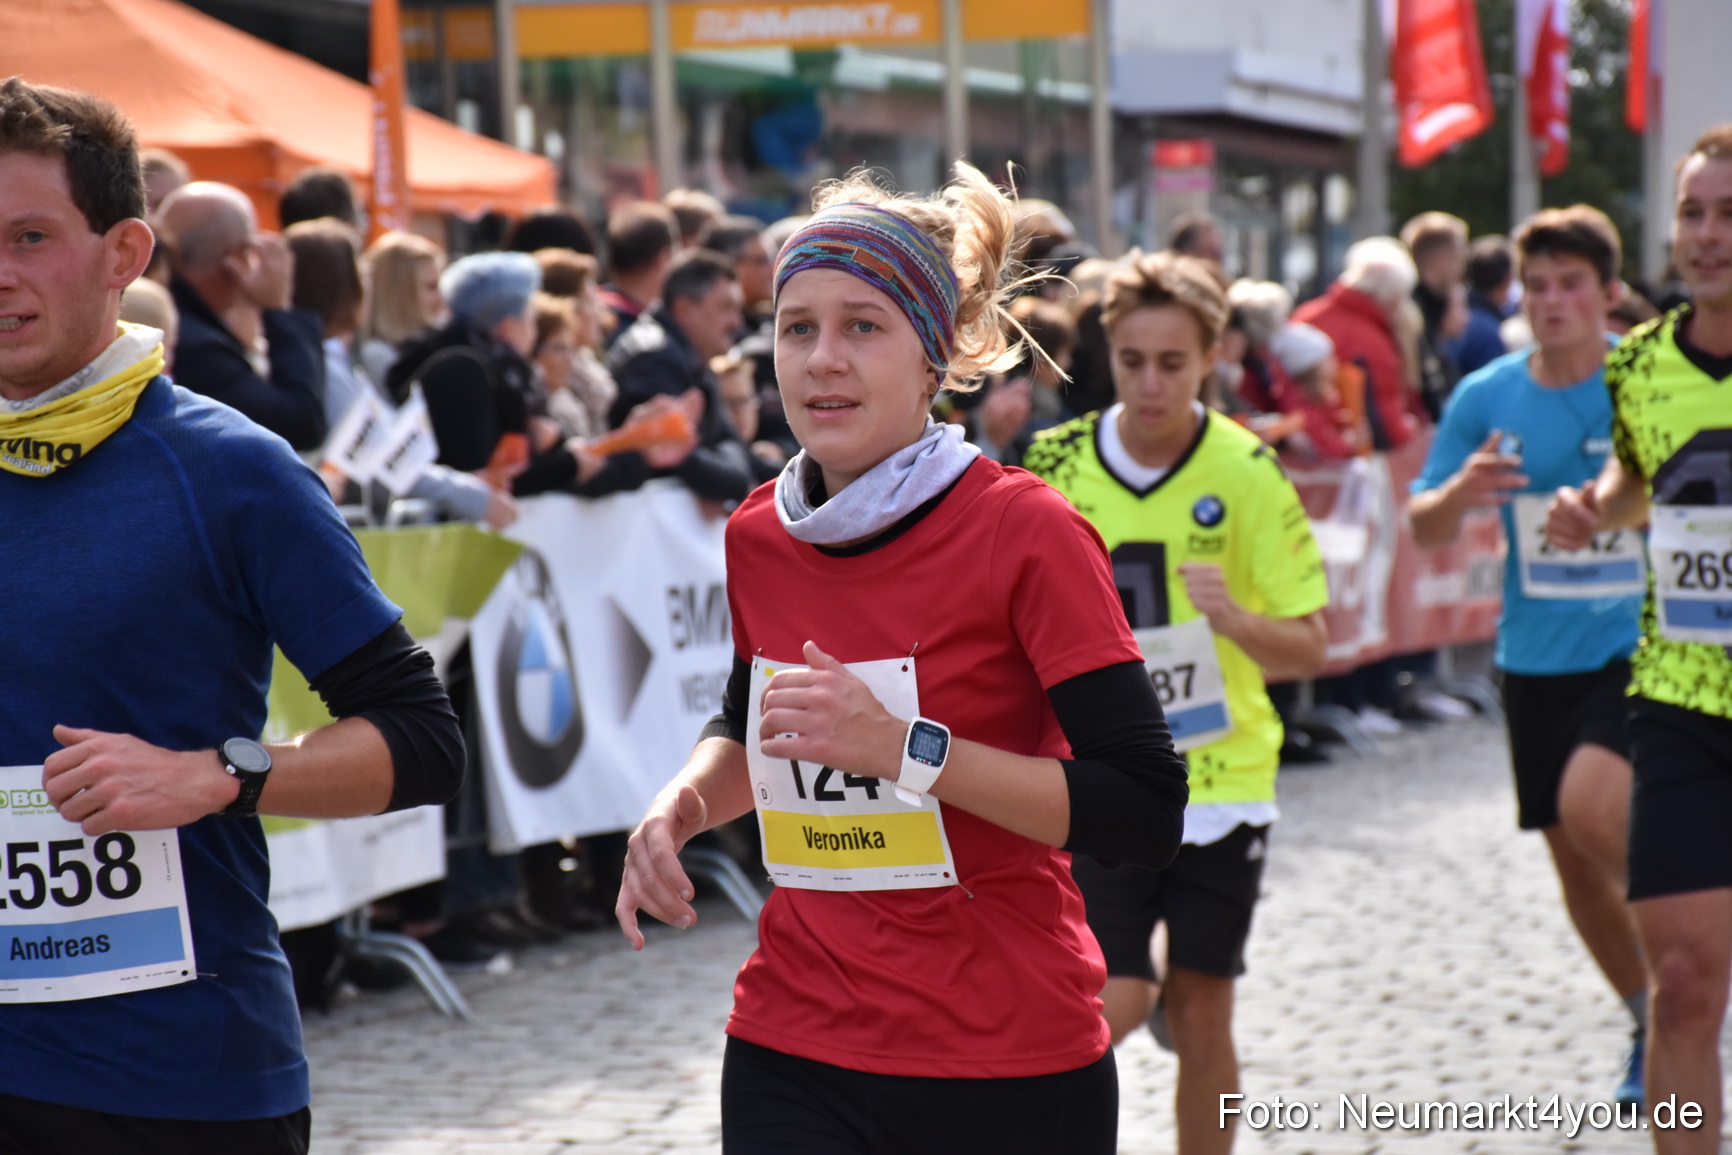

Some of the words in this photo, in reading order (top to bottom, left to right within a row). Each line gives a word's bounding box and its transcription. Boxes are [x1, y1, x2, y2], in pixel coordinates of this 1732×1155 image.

[0, 437, 82, 470] ving
[2, 453, 52, 475] zealand
[802, 825, 886, 852] Veronika
[0, 831, 142, 910] 558
[10, 934, 111, 961] Andreas
